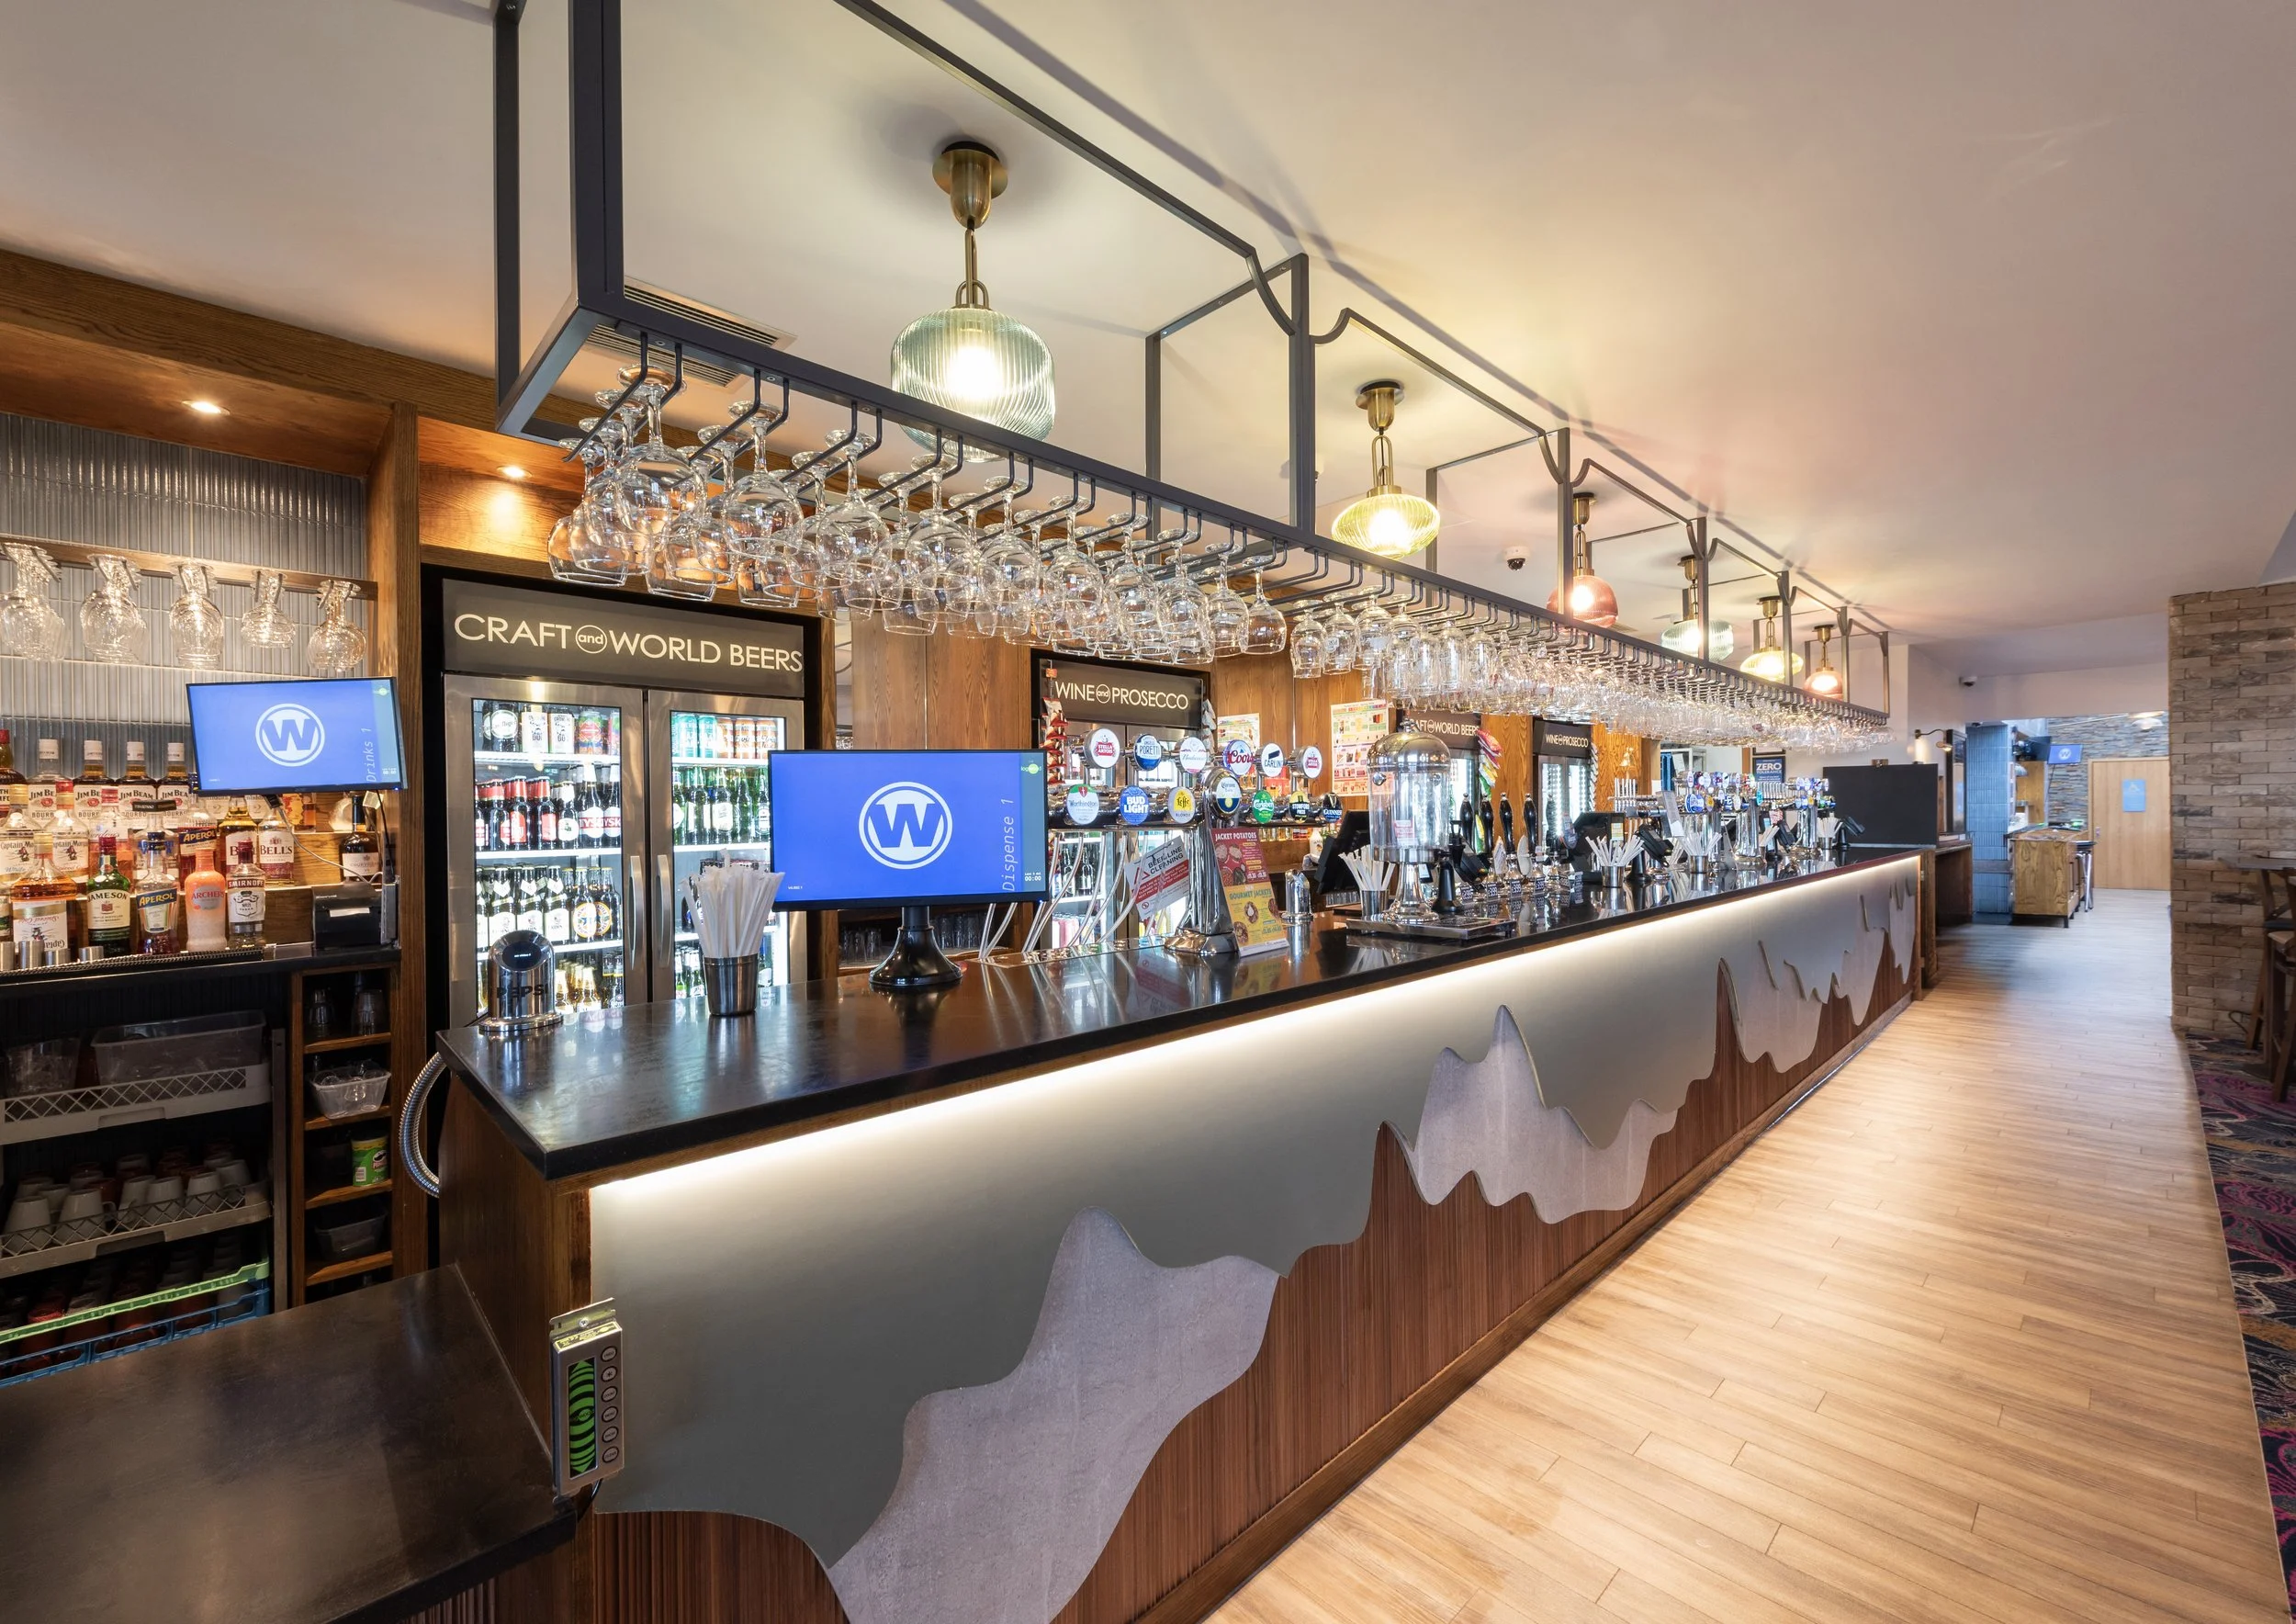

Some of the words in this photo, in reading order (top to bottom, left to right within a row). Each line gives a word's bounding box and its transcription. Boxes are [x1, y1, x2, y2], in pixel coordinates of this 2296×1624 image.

[454, 613, 572, 649] CRAFT
[578, 634, 604, 645] and
[608, 630, 722, 664] WORLD
[729, 643, 804, 672] BEERS
[1055, 681, 1095, 702] WINE
[1097, 690, 1109, 698] and
[1111, 686, 1188, 710] PROSECCO
[1434, 721, 1460, 735] WORLD
[1545, 734, 1559, 745] WINE
[1562, 735, 1589, 748] PROSECCO
[363, 740, 377, 783] Drinks
[1226, 750, 1255, 764] Coors
[1756, 762, 1783, 771] ZERO
[1221, 781, 1236, 789] Corona
[29, 791, 43, 800] JIM
[44, 789, 55, 797] BE
[75, 791, 90, 800] JIM
[90, 789, 100, 797] BE
[118, 792, 132, 800] JIM
[133, 790, 153, 800] BEAM
[162, 792, 174, 800] JIM
[1126, 795, 1146, 805] BUD
[1176, 796, 1191, 808] Leffe
[1253, 798, 1275, 810] Carlsberg
[1123, 805, 1149, 814] LIGHT
[183, 829, 215, 842] APEROL
[1214, 831, 1232, 841] JACKET
[1232, 831, 1257, 840] POTATOES
[260, 845, 293, 855] BELL'S
[1002, 816, 1019, 892] Dispense
[1167, 845, 1183, 858] LINE
[228, 879, 264, 888] SMIRNOFF
[87, 891, 129, 902] JAMESON
[139, 893, 174, 907] APEROL
[1229, 891, 1253, 900] GOURMET
[1254, 888, 1272, 898] JACKETS
[496, 983, 549, 999] PEPSI
